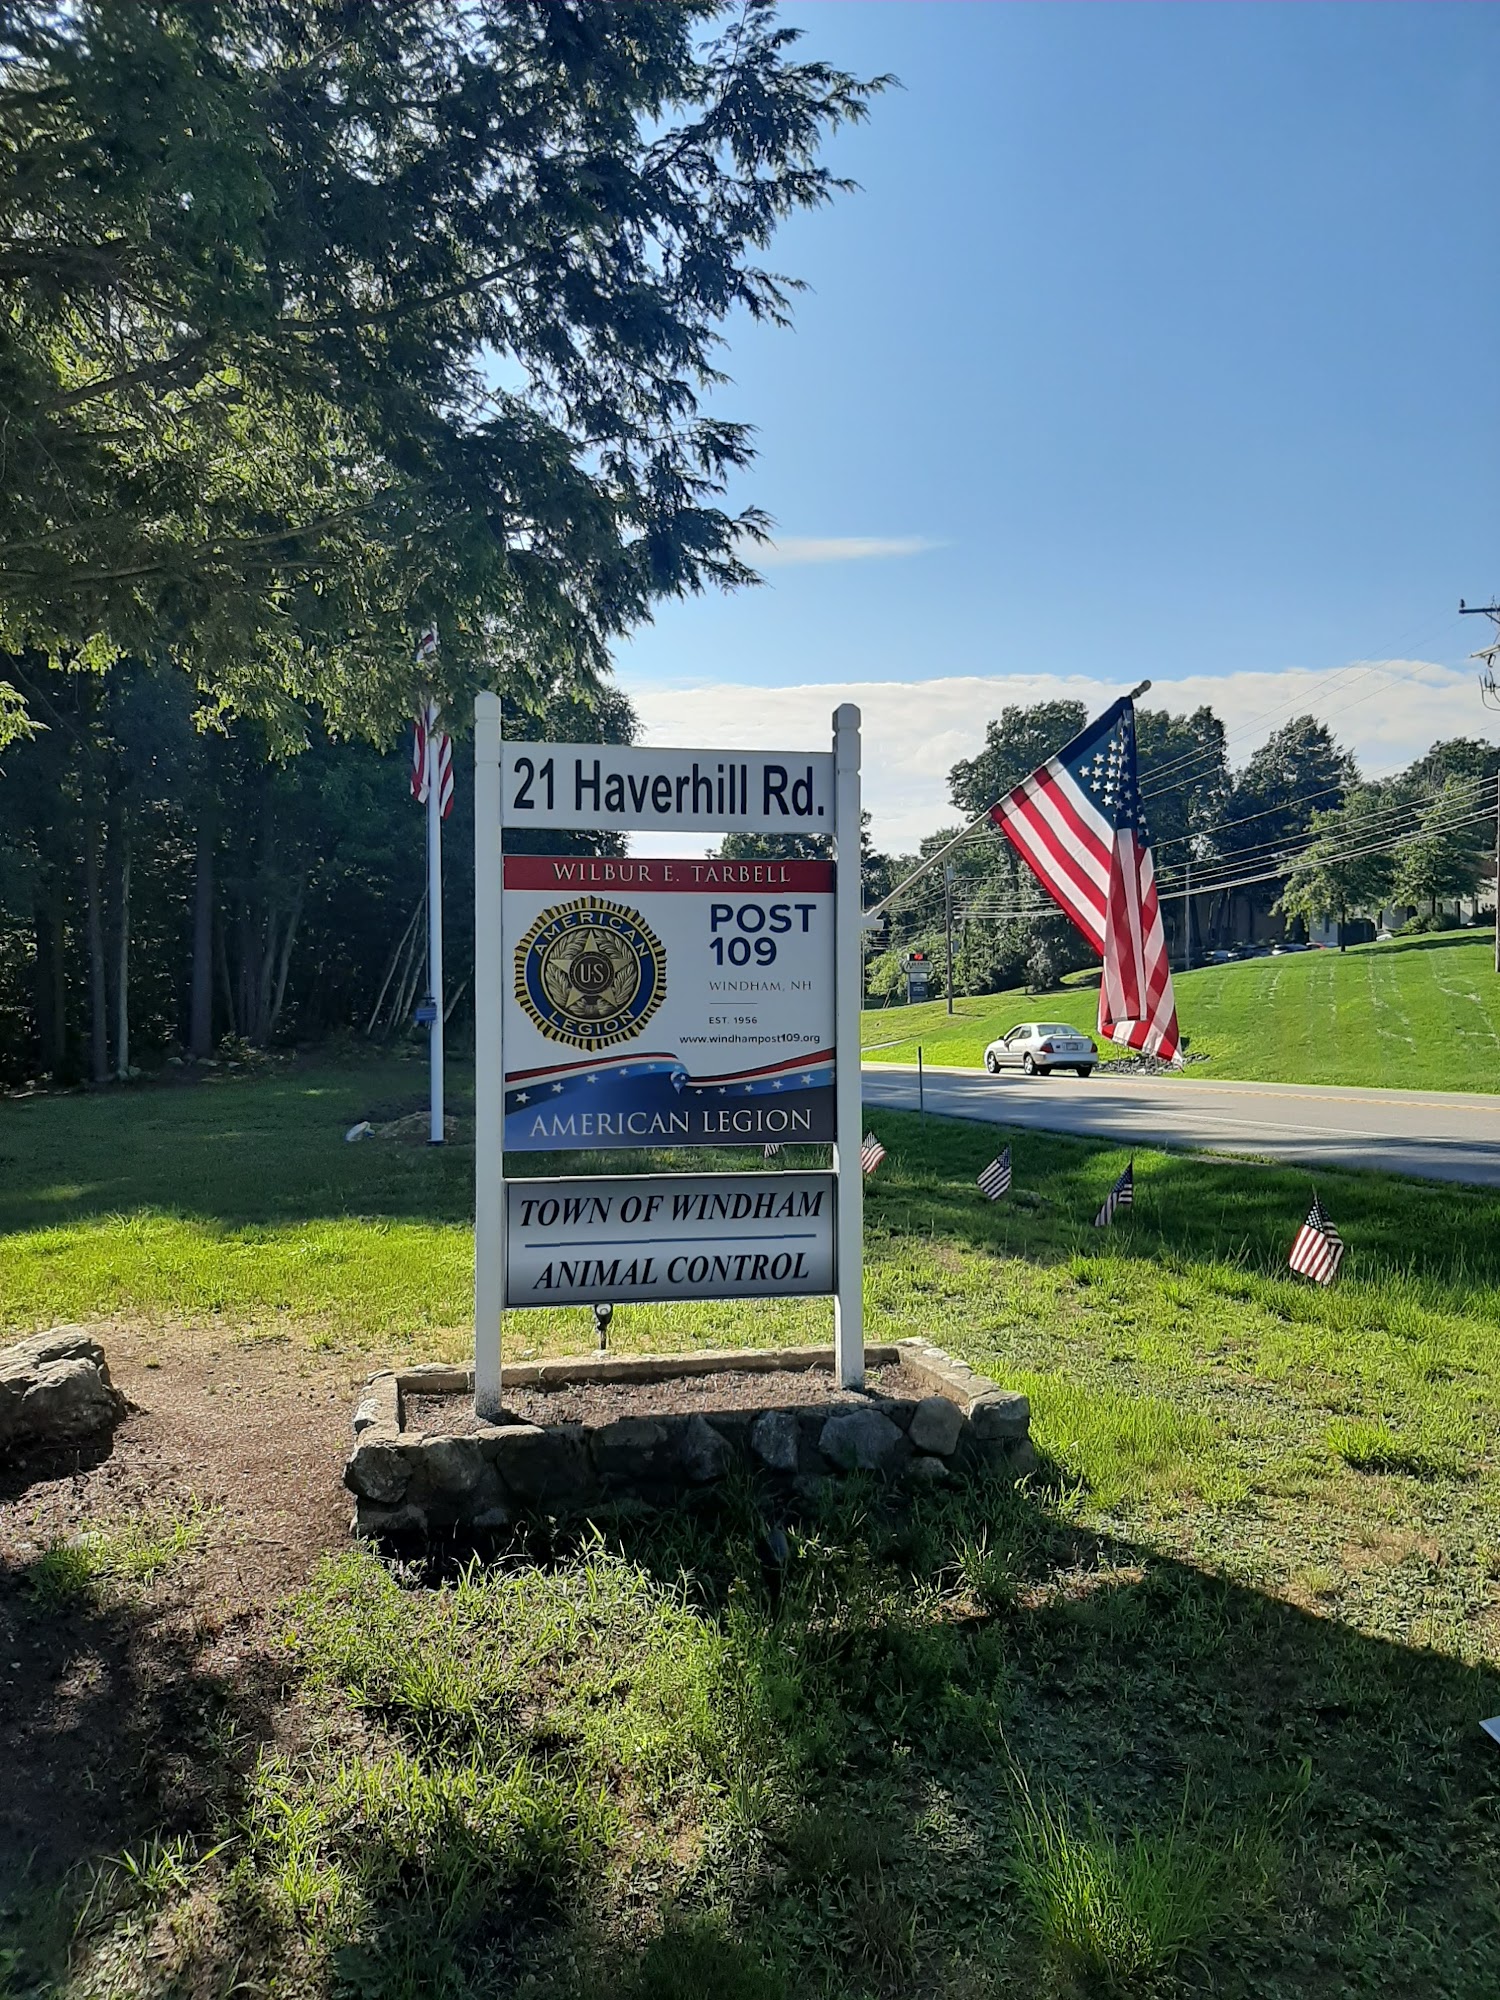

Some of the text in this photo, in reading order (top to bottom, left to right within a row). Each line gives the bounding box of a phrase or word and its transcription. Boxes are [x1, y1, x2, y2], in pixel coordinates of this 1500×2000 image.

[513, 757, 825, 816] 21 Haverhill Rd.
[553, 863, 791, 883] WILBUR E. TARBELL
[711, 904, 817, 933] POST
[534, 912, 650, 957] AMERICAN
[709, 937, 777, 966] 109
[709, 981, 812, 992] WINDHAM, NH
[549, 1010, 635, 1035] LEGION
[708, 1016, 758, 1024] EST. 1956
[679, 1033, 820, 1045] www.windhampost109.org
[529, 1108, 812, 1137] AMERICAN LEGION
[520, 1190, 826, 1226] TOWN OF WINDHAM
[532, 1252, 810, 1289] ANIMAL CONTROL
